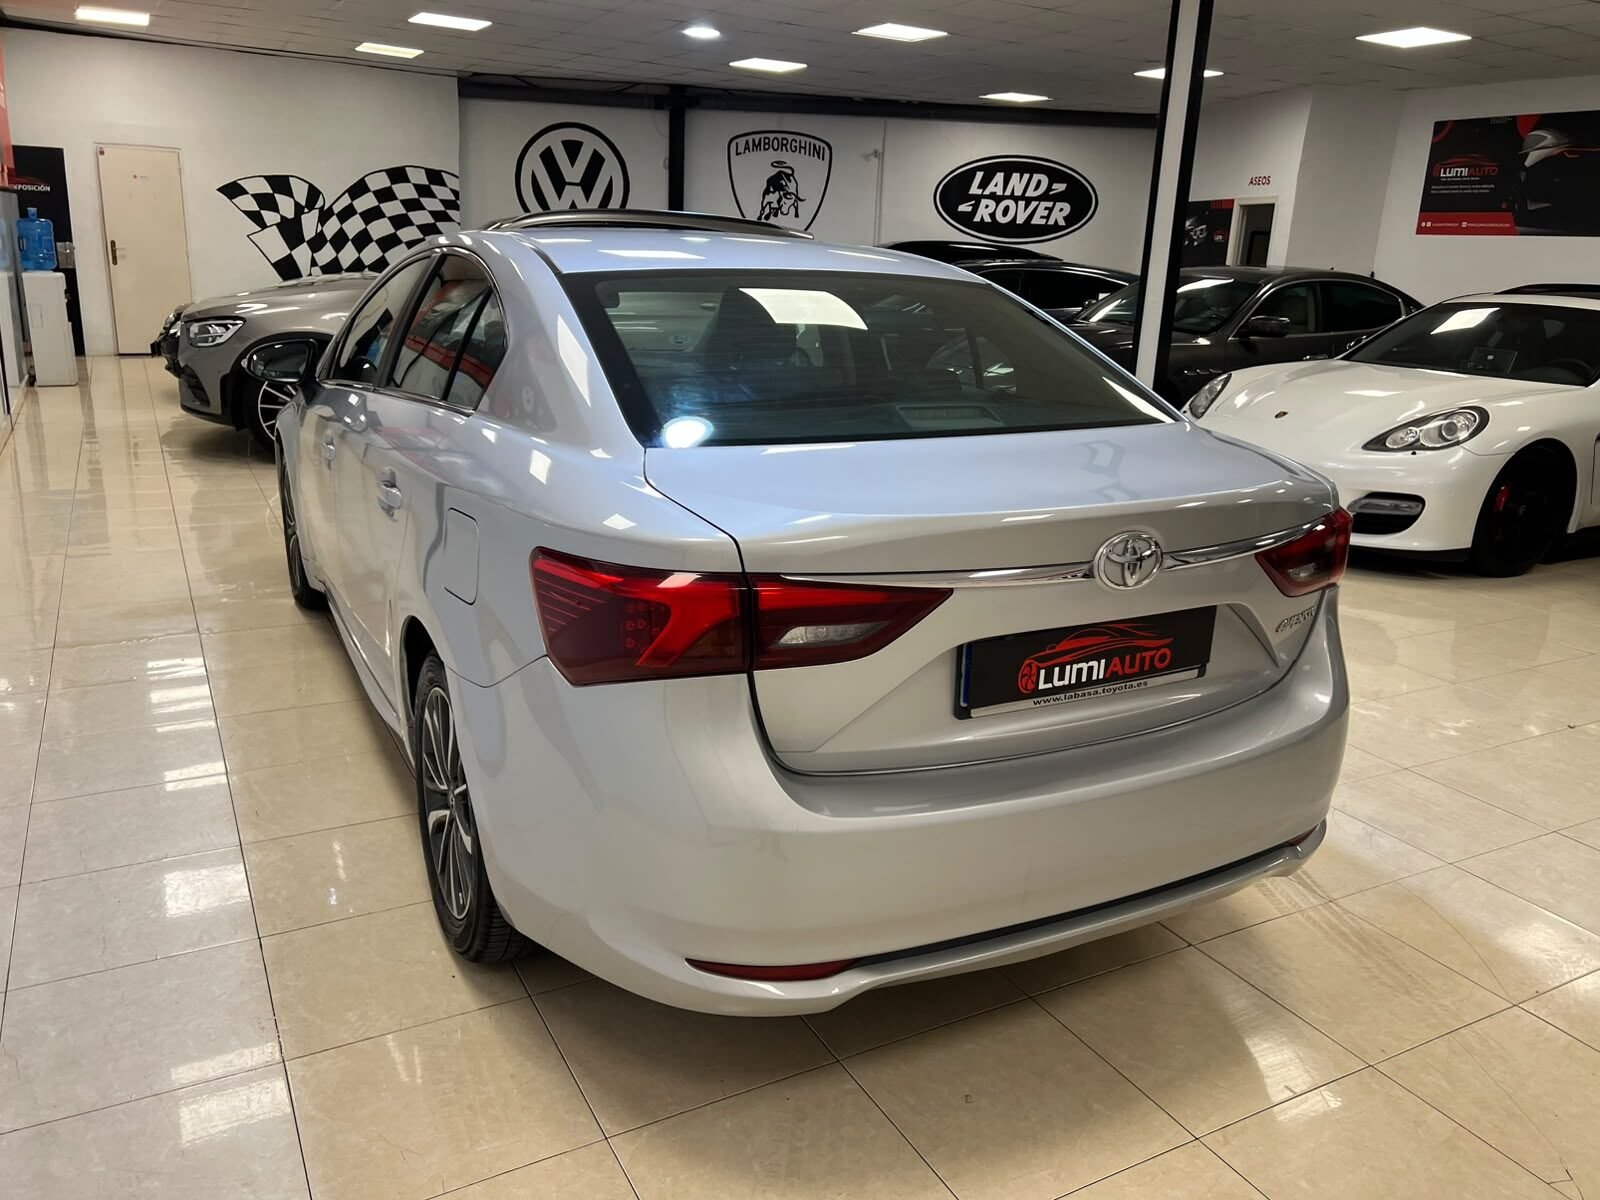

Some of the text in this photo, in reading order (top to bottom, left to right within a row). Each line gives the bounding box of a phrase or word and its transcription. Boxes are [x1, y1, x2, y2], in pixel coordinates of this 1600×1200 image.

[735, 136, 825, 161] LAMBORGHINI
[968, 171, 1049, 197] LAND
[1248, 175, 1271, 186] ASEOS
[1440, 167, 1498, 177] LUMIAUTO
[973, 198, 1071, 226] ROVER
[1038, 648, 1171, 690] LUMIAUTO
